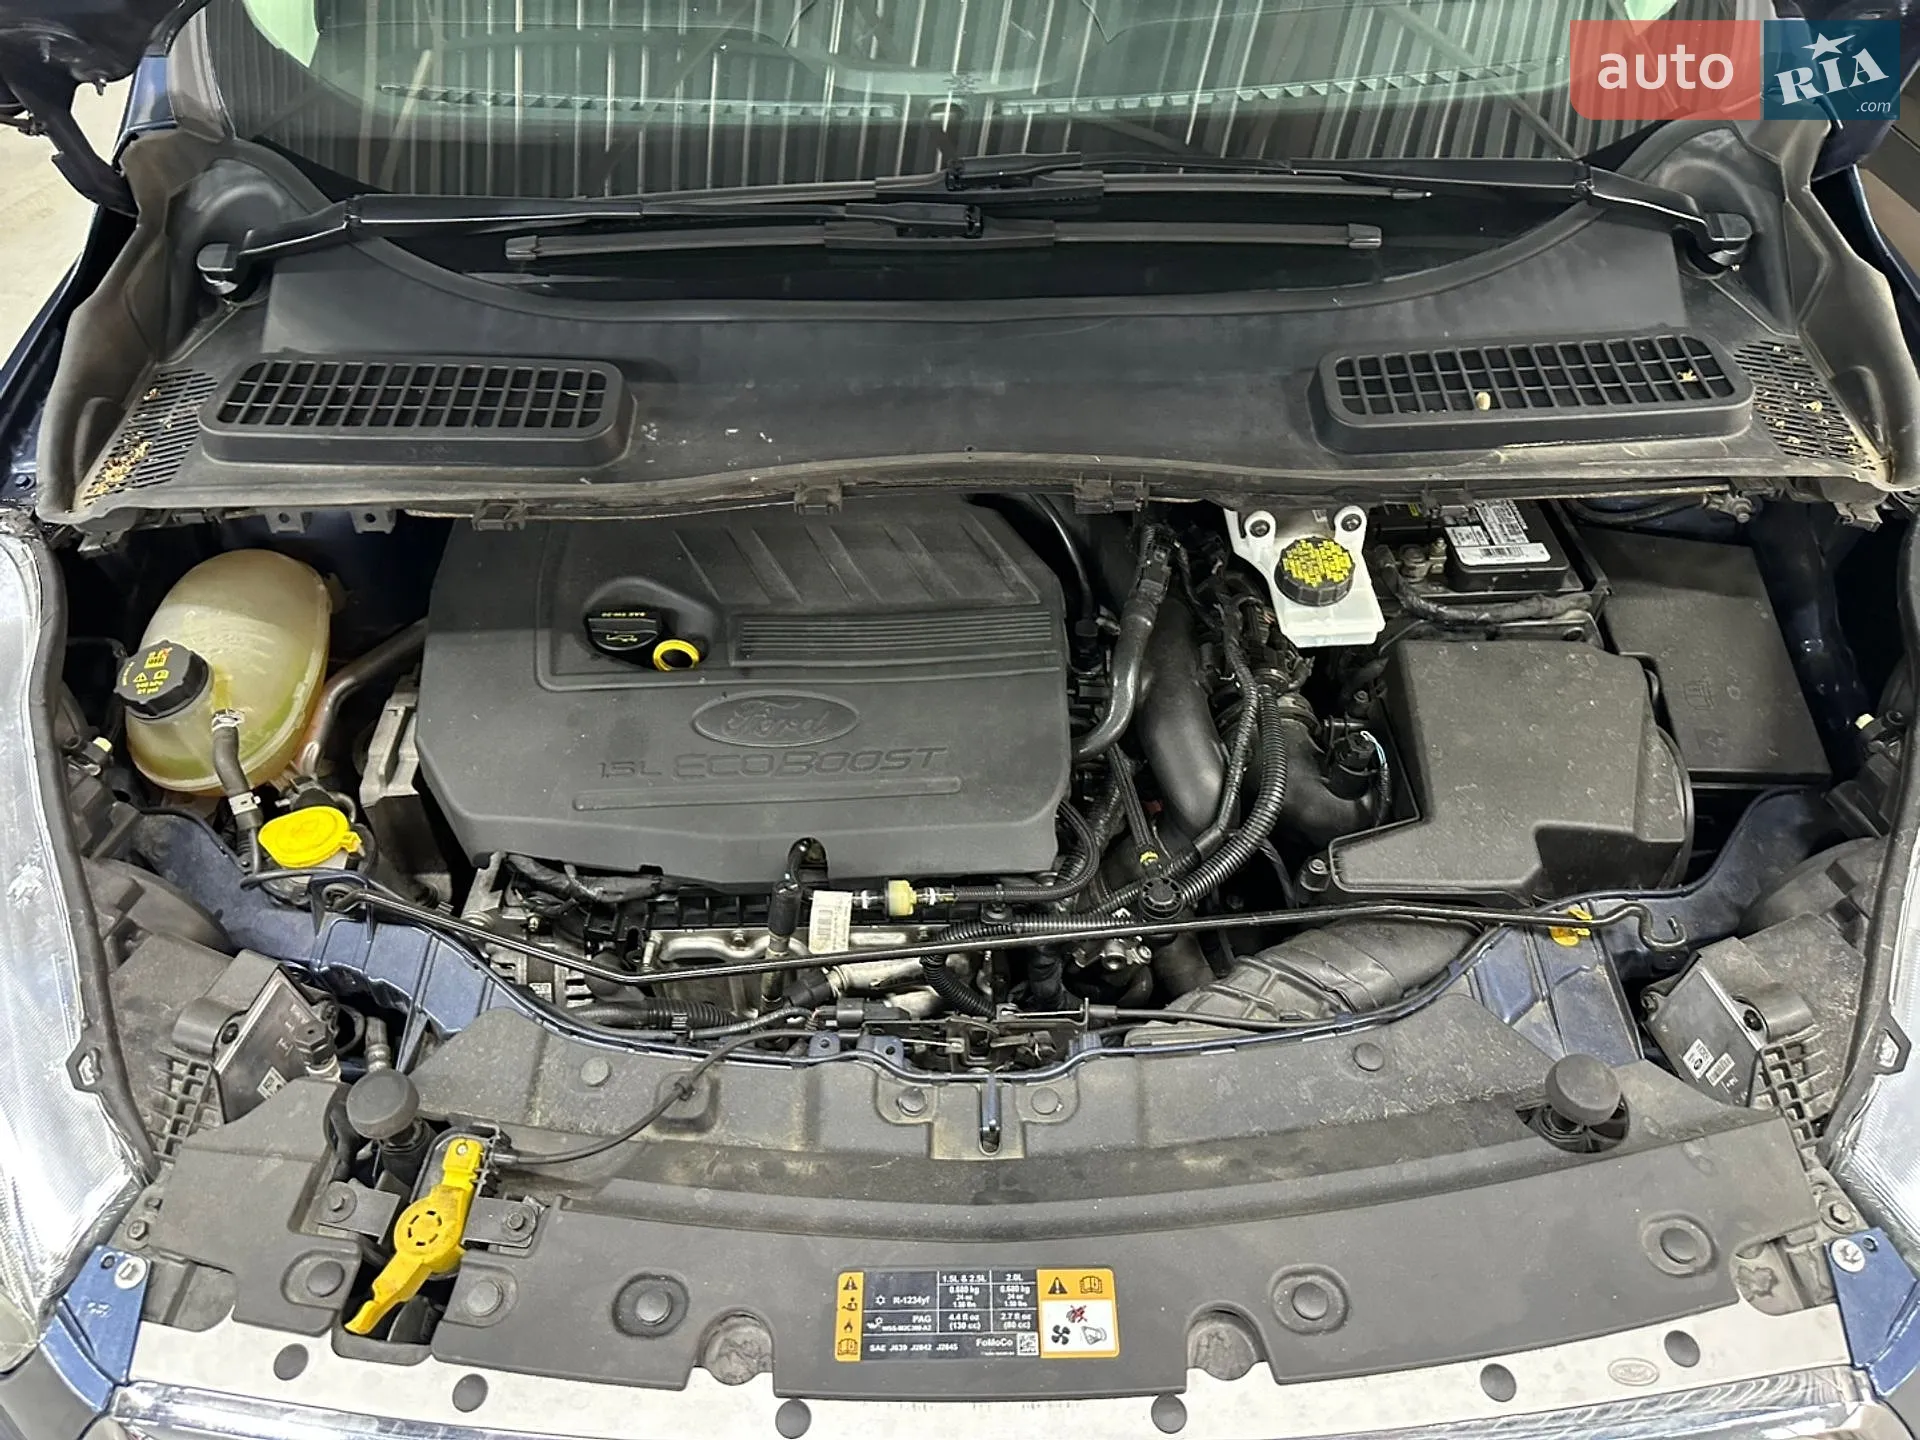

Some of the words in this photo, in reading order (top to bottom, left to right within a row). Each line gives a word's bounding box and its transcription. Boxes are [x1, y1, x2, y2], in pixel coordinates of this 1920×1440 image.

[721, 700, 832, 738] Ford
[599, 760, 663, 779] 1.5L
[942, 1274, 959, 1283] 1.5L
[960, 1274, 968, 1283] &
[968, 1274, 987, 1283] 2.5L
[1005, 1273, 1024, 1281] 2.0L
[969, 1285, 980, 1296] kg
[1020, 1285, 1031, 1295] kg
[893, 1296, 930, 1306] R-1234yf
[912, 1315, 932, 1323] PAG
[949, 1321, 967, 1331] (130
[967, 1321, 981, 1331] cc)
[1017, 1321, 1031, 1330] cc)
[975, 1337, 1014, 1347] FoMoCo
[869, 1343, 887, 1352] SAE
